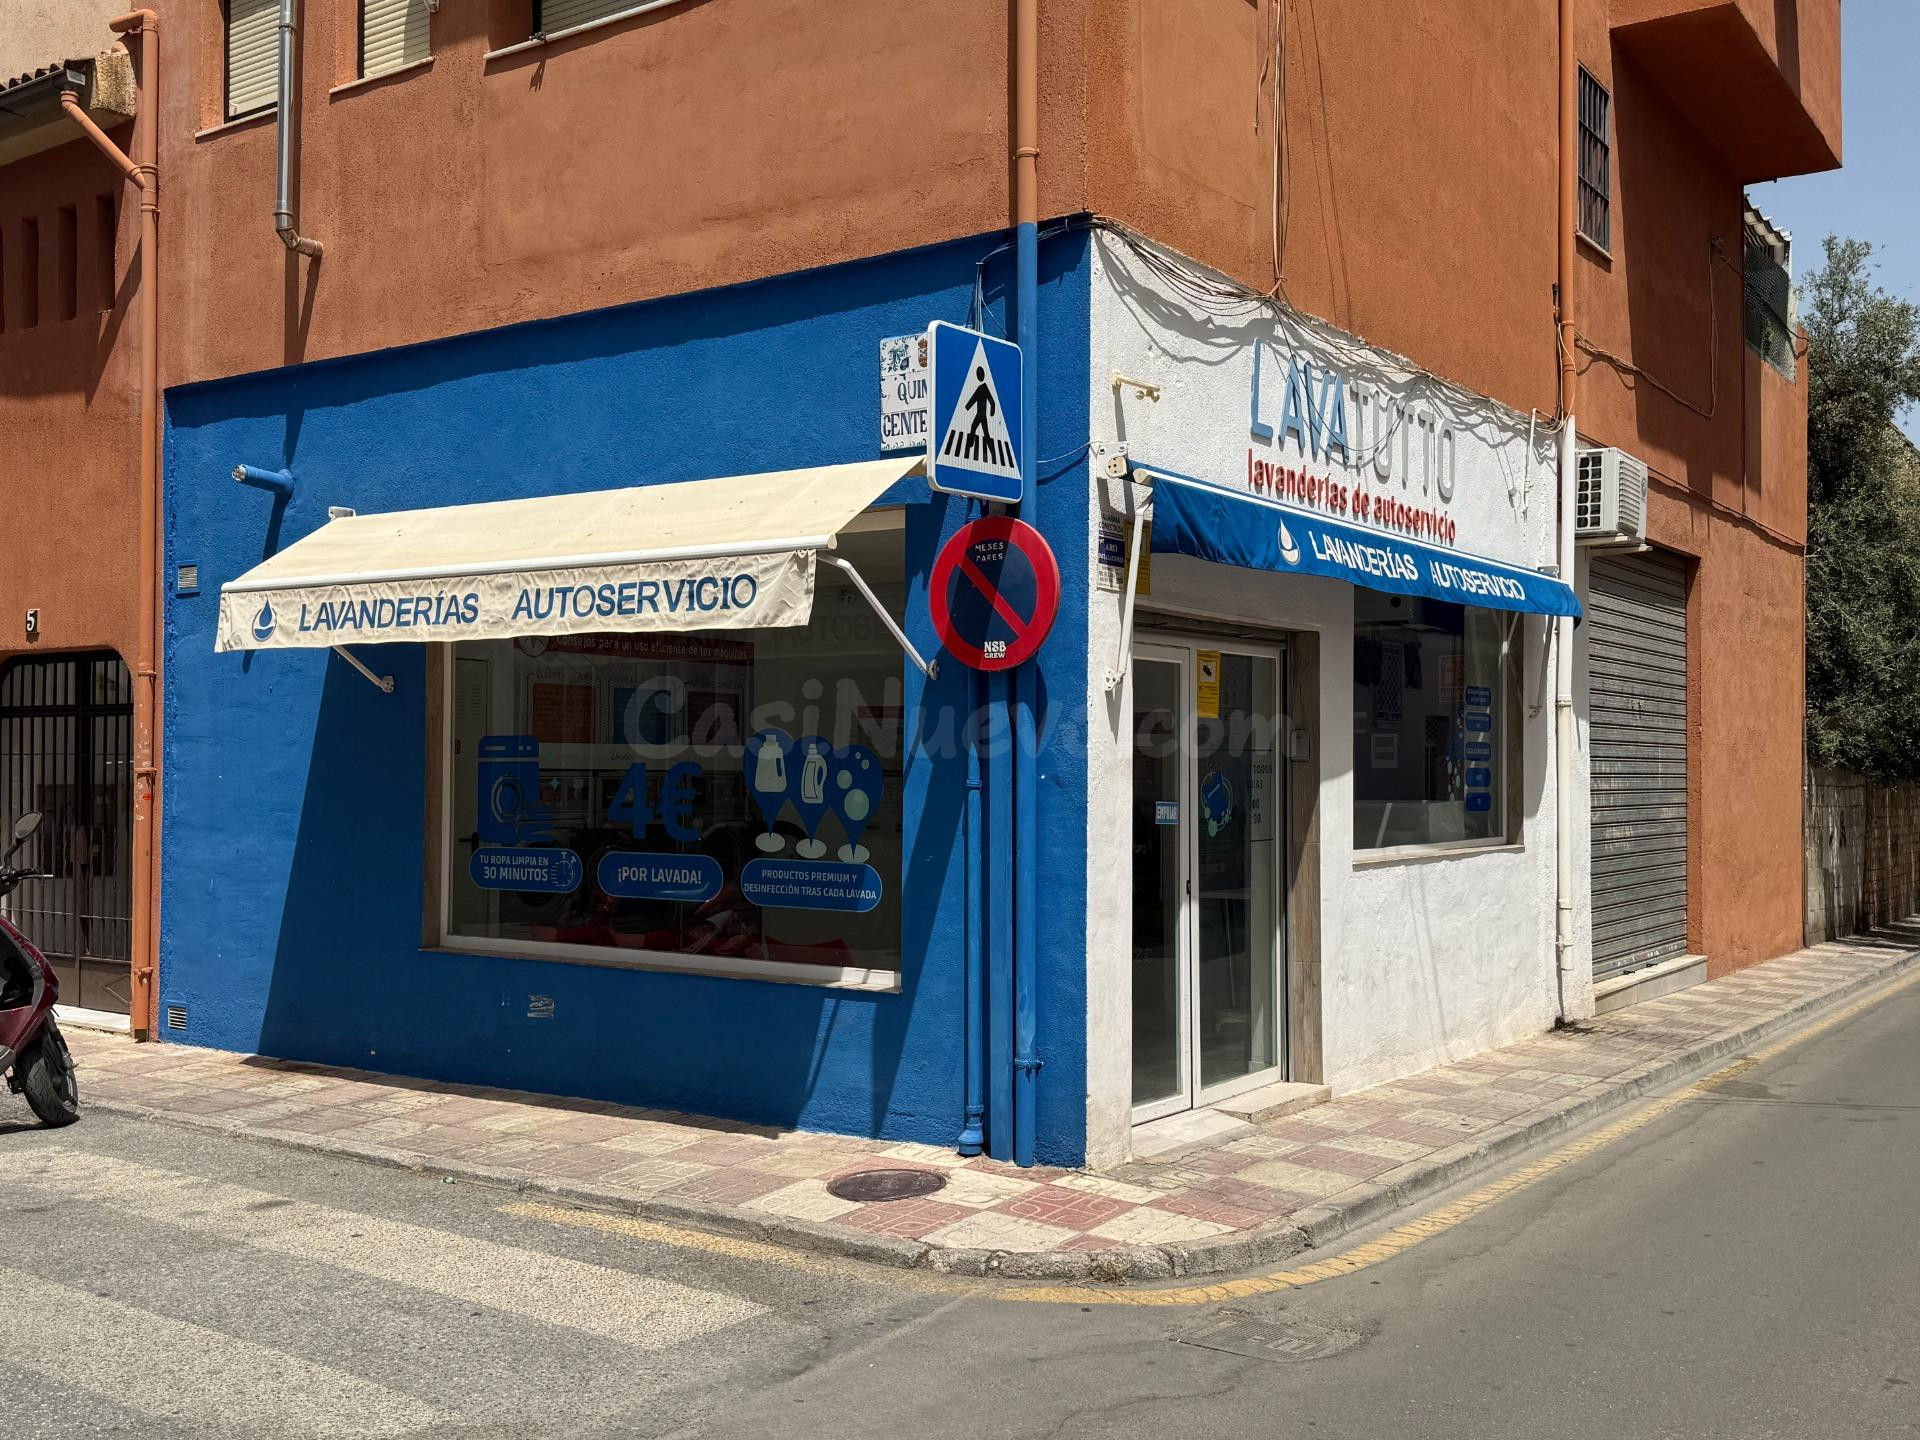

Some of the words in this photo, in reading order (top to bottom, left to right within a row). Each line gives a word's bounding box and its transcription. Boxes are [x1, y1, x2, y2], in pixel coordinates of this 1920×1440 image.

[1352, 482, 1370, 518] de
[1373, 484, 1457, 542] autoservicio
[975, 541, 1004, 551] MESES
[1308, 530, 1419, 582] LAVANDERÍAS
[1431, 559, 1526, 602] AUTOSERVICIO
[298, 590, 479, 632] LAVANDERÍAS
[511, 573, 757, 621] AUTOSERVICIO
[26, 610, 36, 632] 5
[599, 639, 618, 652] para
[621, 641, 632, 651] un
[634, 642, 648, 650] uso
[688, 645, 698, 654] de
[984, 640, 1007, 653] NSB
[607, 761, 704, 841] 4€
[480, 854, 490, 863] TU
[491, 855, 511, 865] ROPA
[512, 855, 537, 865] LIMPIA
[539, 856, 549, 866] EN
[484, 866, 497, 879] 30
[500, 867, 549, 881] MINUTOS
[618, 867, 647, 883] ¡POR
[651, 868, 702, 884] LAVADA!
[762, 869, 810, 881] PRODUCTOS
[811, 870, 850, 883] PREMIUM
[851, 874, 857, 883] Y
[744, 882, 800, 895] DESINFECCIÓN
[802, 886, 822, 897] TRAS
[823, 887, 845, 898] CADA
[846, 888, 877, 900] LAVADA
